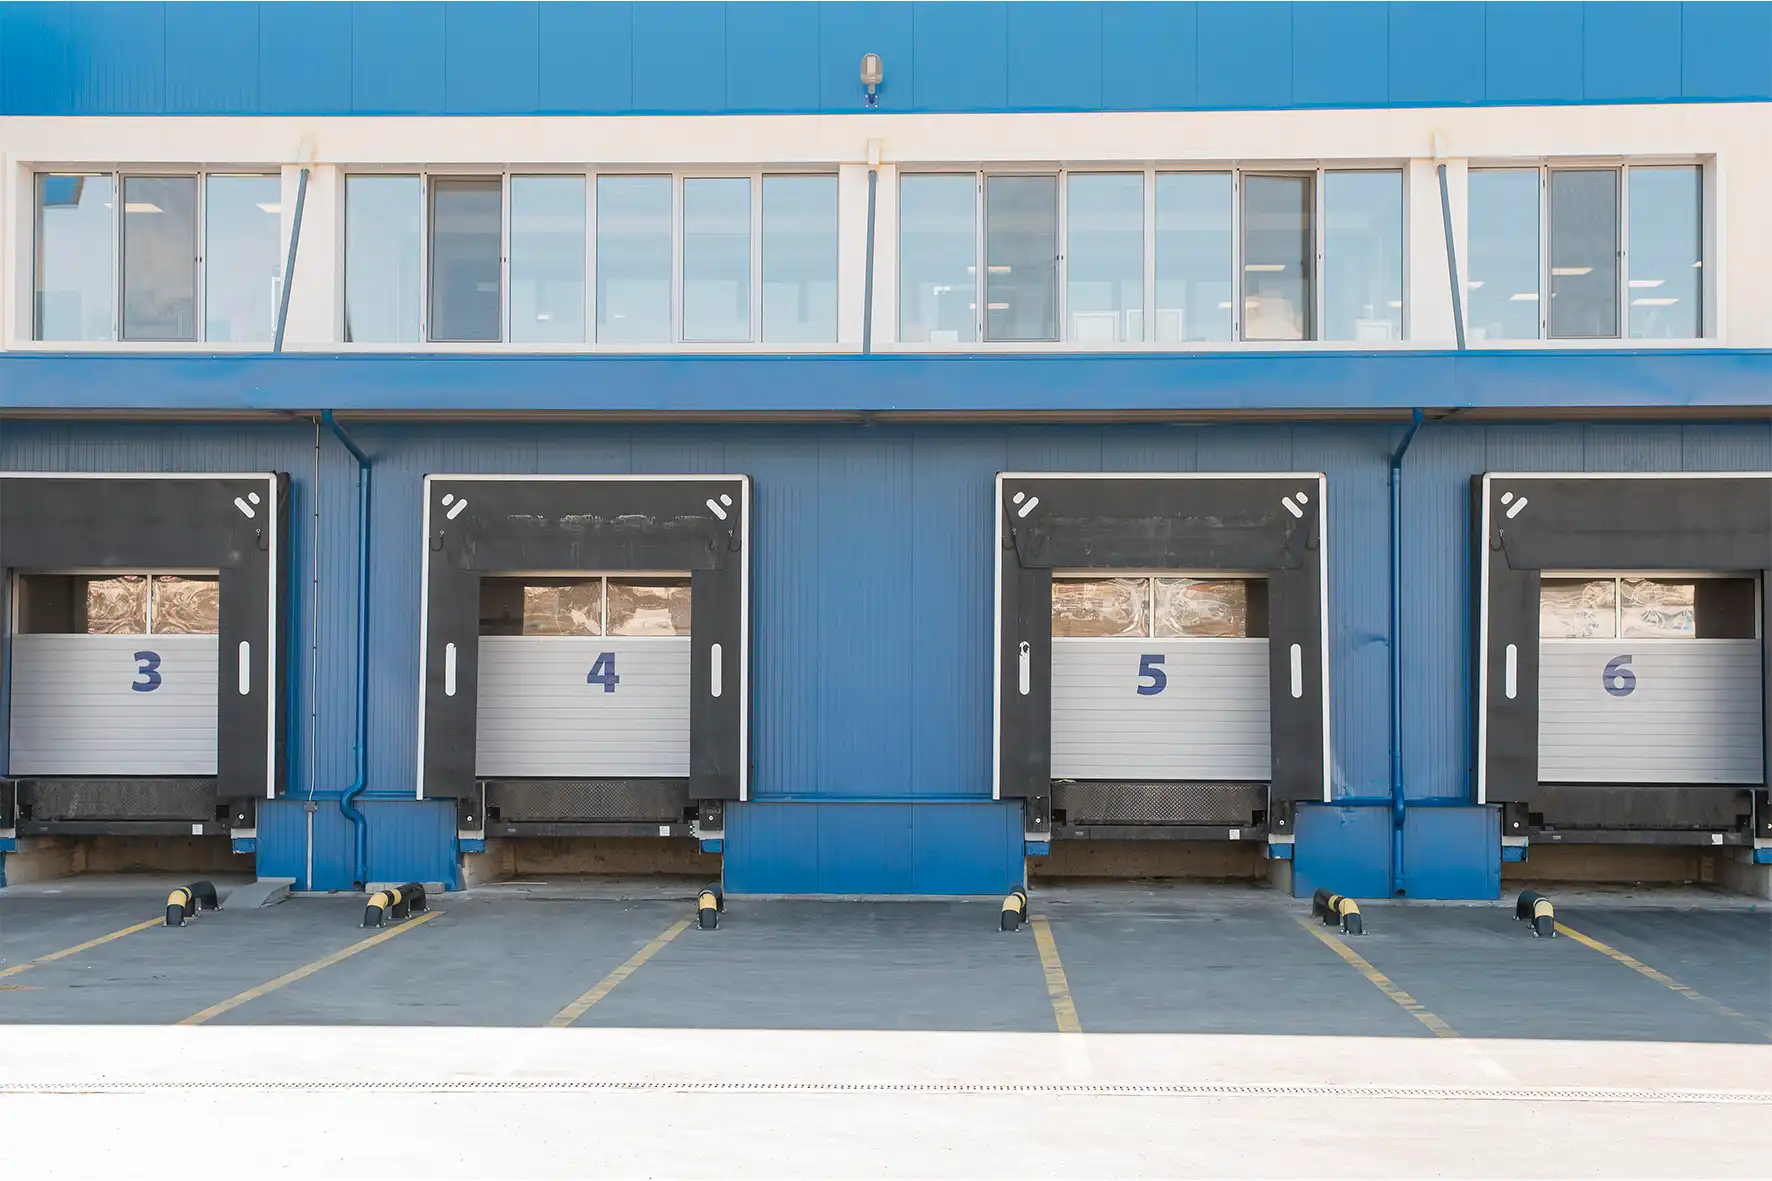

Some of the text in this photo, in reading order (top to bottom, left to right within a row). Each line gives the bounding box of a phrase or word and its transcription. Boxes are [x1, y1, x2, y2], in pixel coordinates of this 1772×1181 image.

[131, 651, 163, 692] 3
[586, 652, 620, 693] 4
[1137, 654, 1167, 696] 5
[1603, 654, 1636, 697] 6
